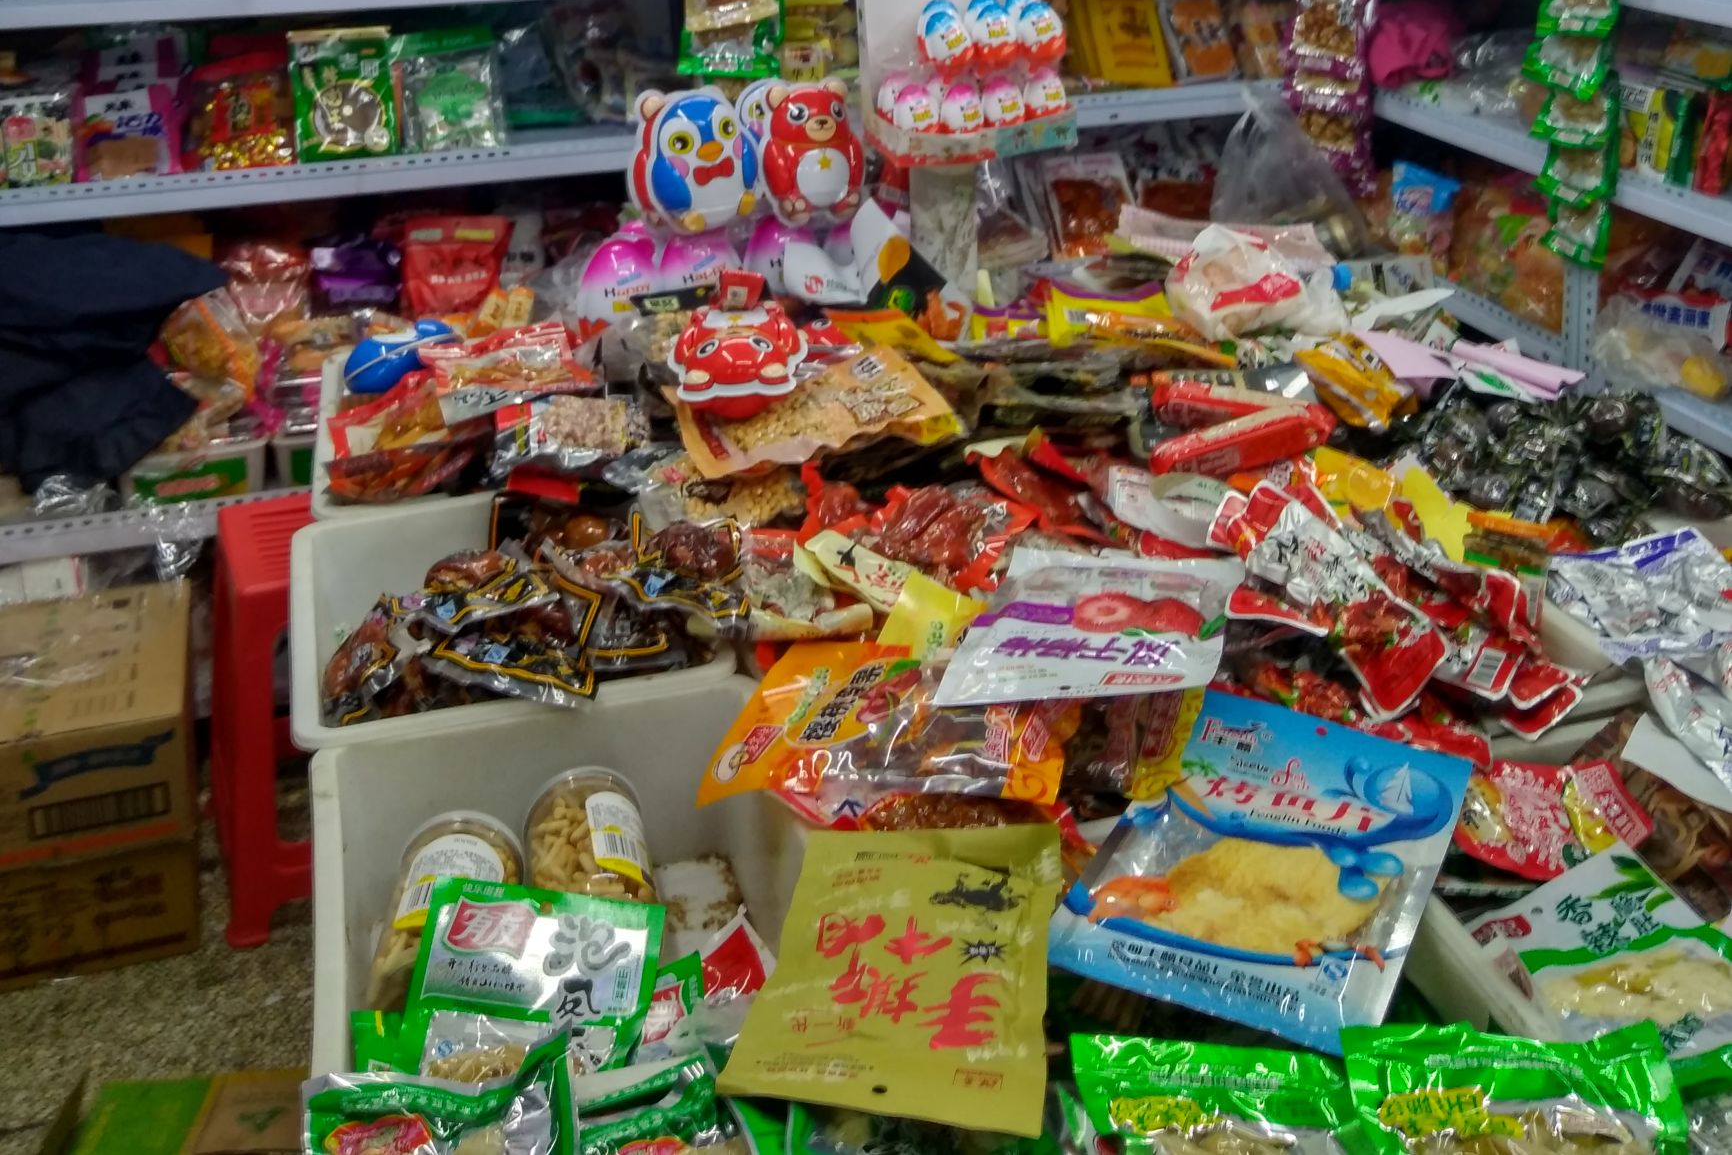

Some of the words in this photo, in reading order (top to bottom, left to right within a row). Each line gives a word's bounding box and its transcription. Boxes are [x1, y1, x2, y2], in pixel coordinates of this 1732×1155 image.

[456, 906, 525, 948] 有友
[815, 913, 953, 966] 牛肉
[790, 1015, 857, 1036] 新一代
